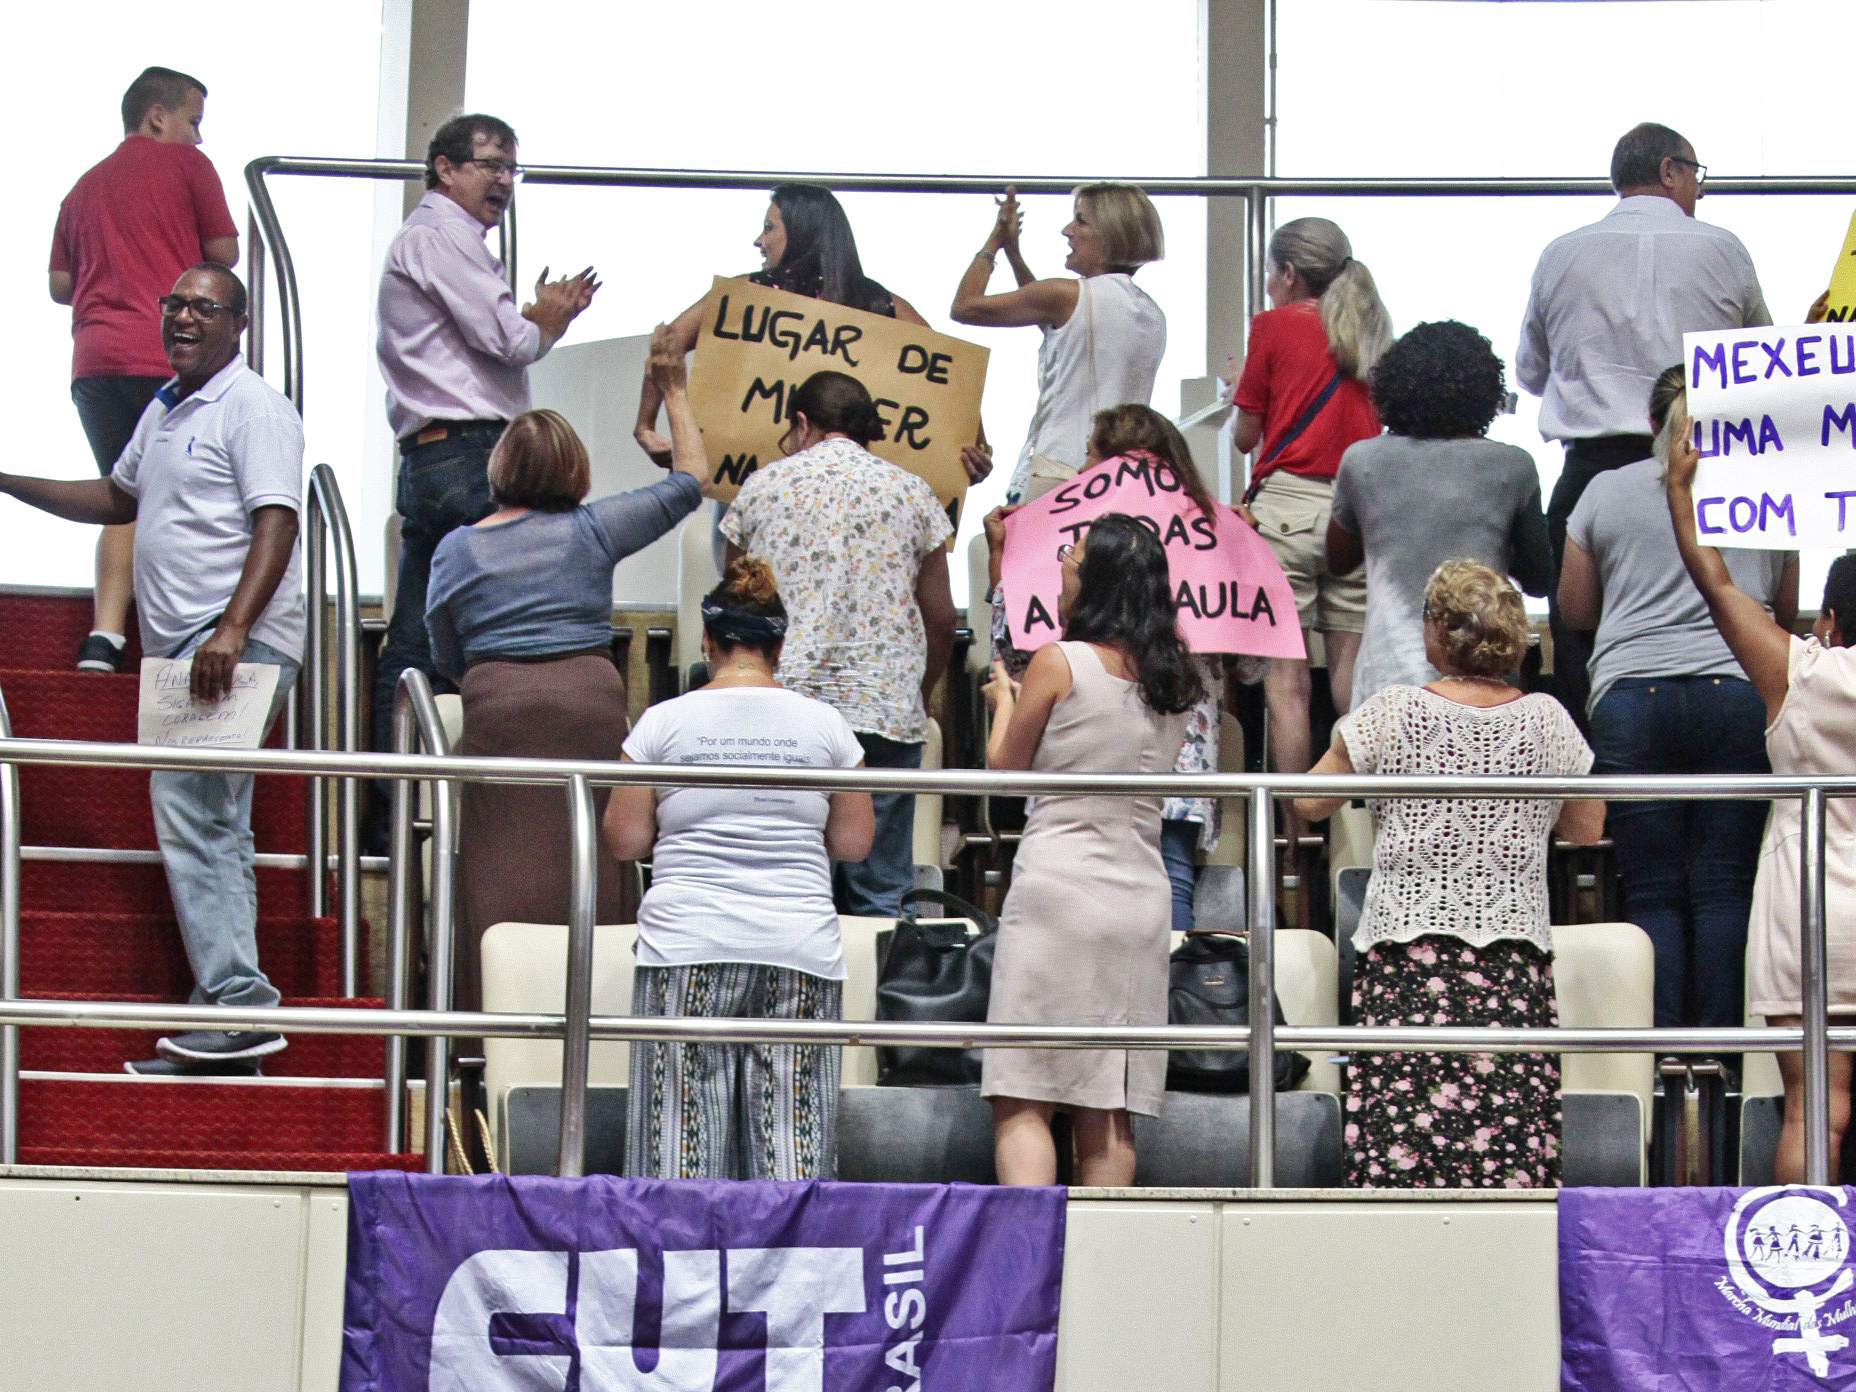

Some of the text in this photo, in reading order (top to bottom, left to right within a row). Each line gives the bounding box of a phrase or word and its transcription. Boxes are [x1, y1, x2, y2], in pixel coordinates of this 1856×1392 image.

[713, 294, 953, 385] LUGAR DE
[1692, 334, 1856, 390] MEXEU
[1694, 414, 1783, 459] UMA
[1049, 457, 1194, 515] SOMO
[1697, 491, 1797, 537] COM
[1175, 579, 1277, 628] AULA
[720, 739, 735, 748] um
[737, 736, 771, 748] mundo
[774, 737, 798, 749] onde
